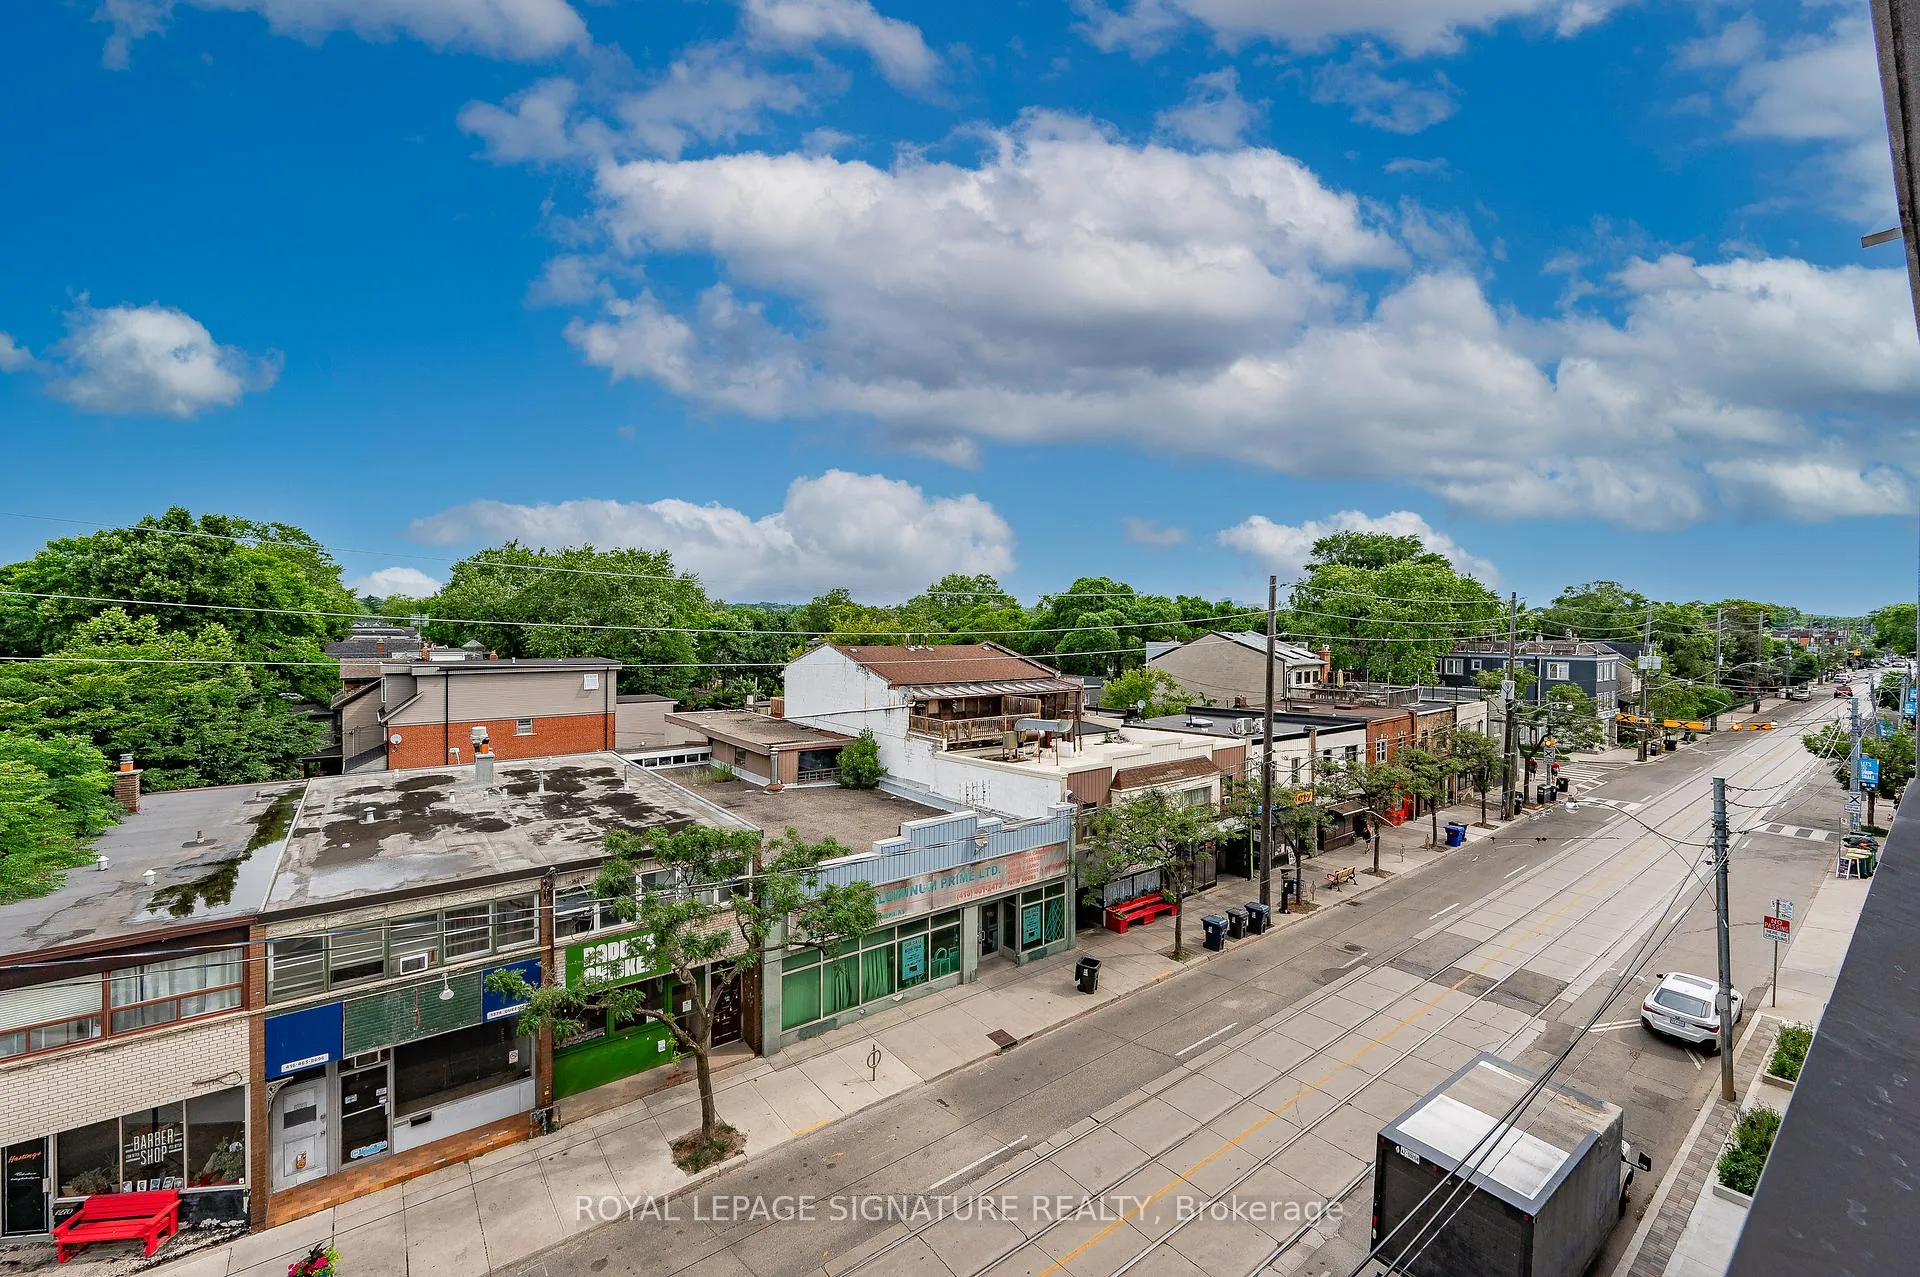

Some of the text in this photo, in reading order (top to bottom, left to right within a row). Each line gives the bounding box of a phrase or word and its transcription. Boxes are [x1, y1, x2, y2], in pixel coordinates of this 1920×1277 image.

[941, 870, 975, 889] PRIME
[978, 865, 1001, 879] LTD.
[1764, 922, 1789, 933] PASSING
[133, 1128, 174, 1151] BARBER
[140, 1145, 168, 1166] SHOP
[54, 1208, 74, 1216] 1270
